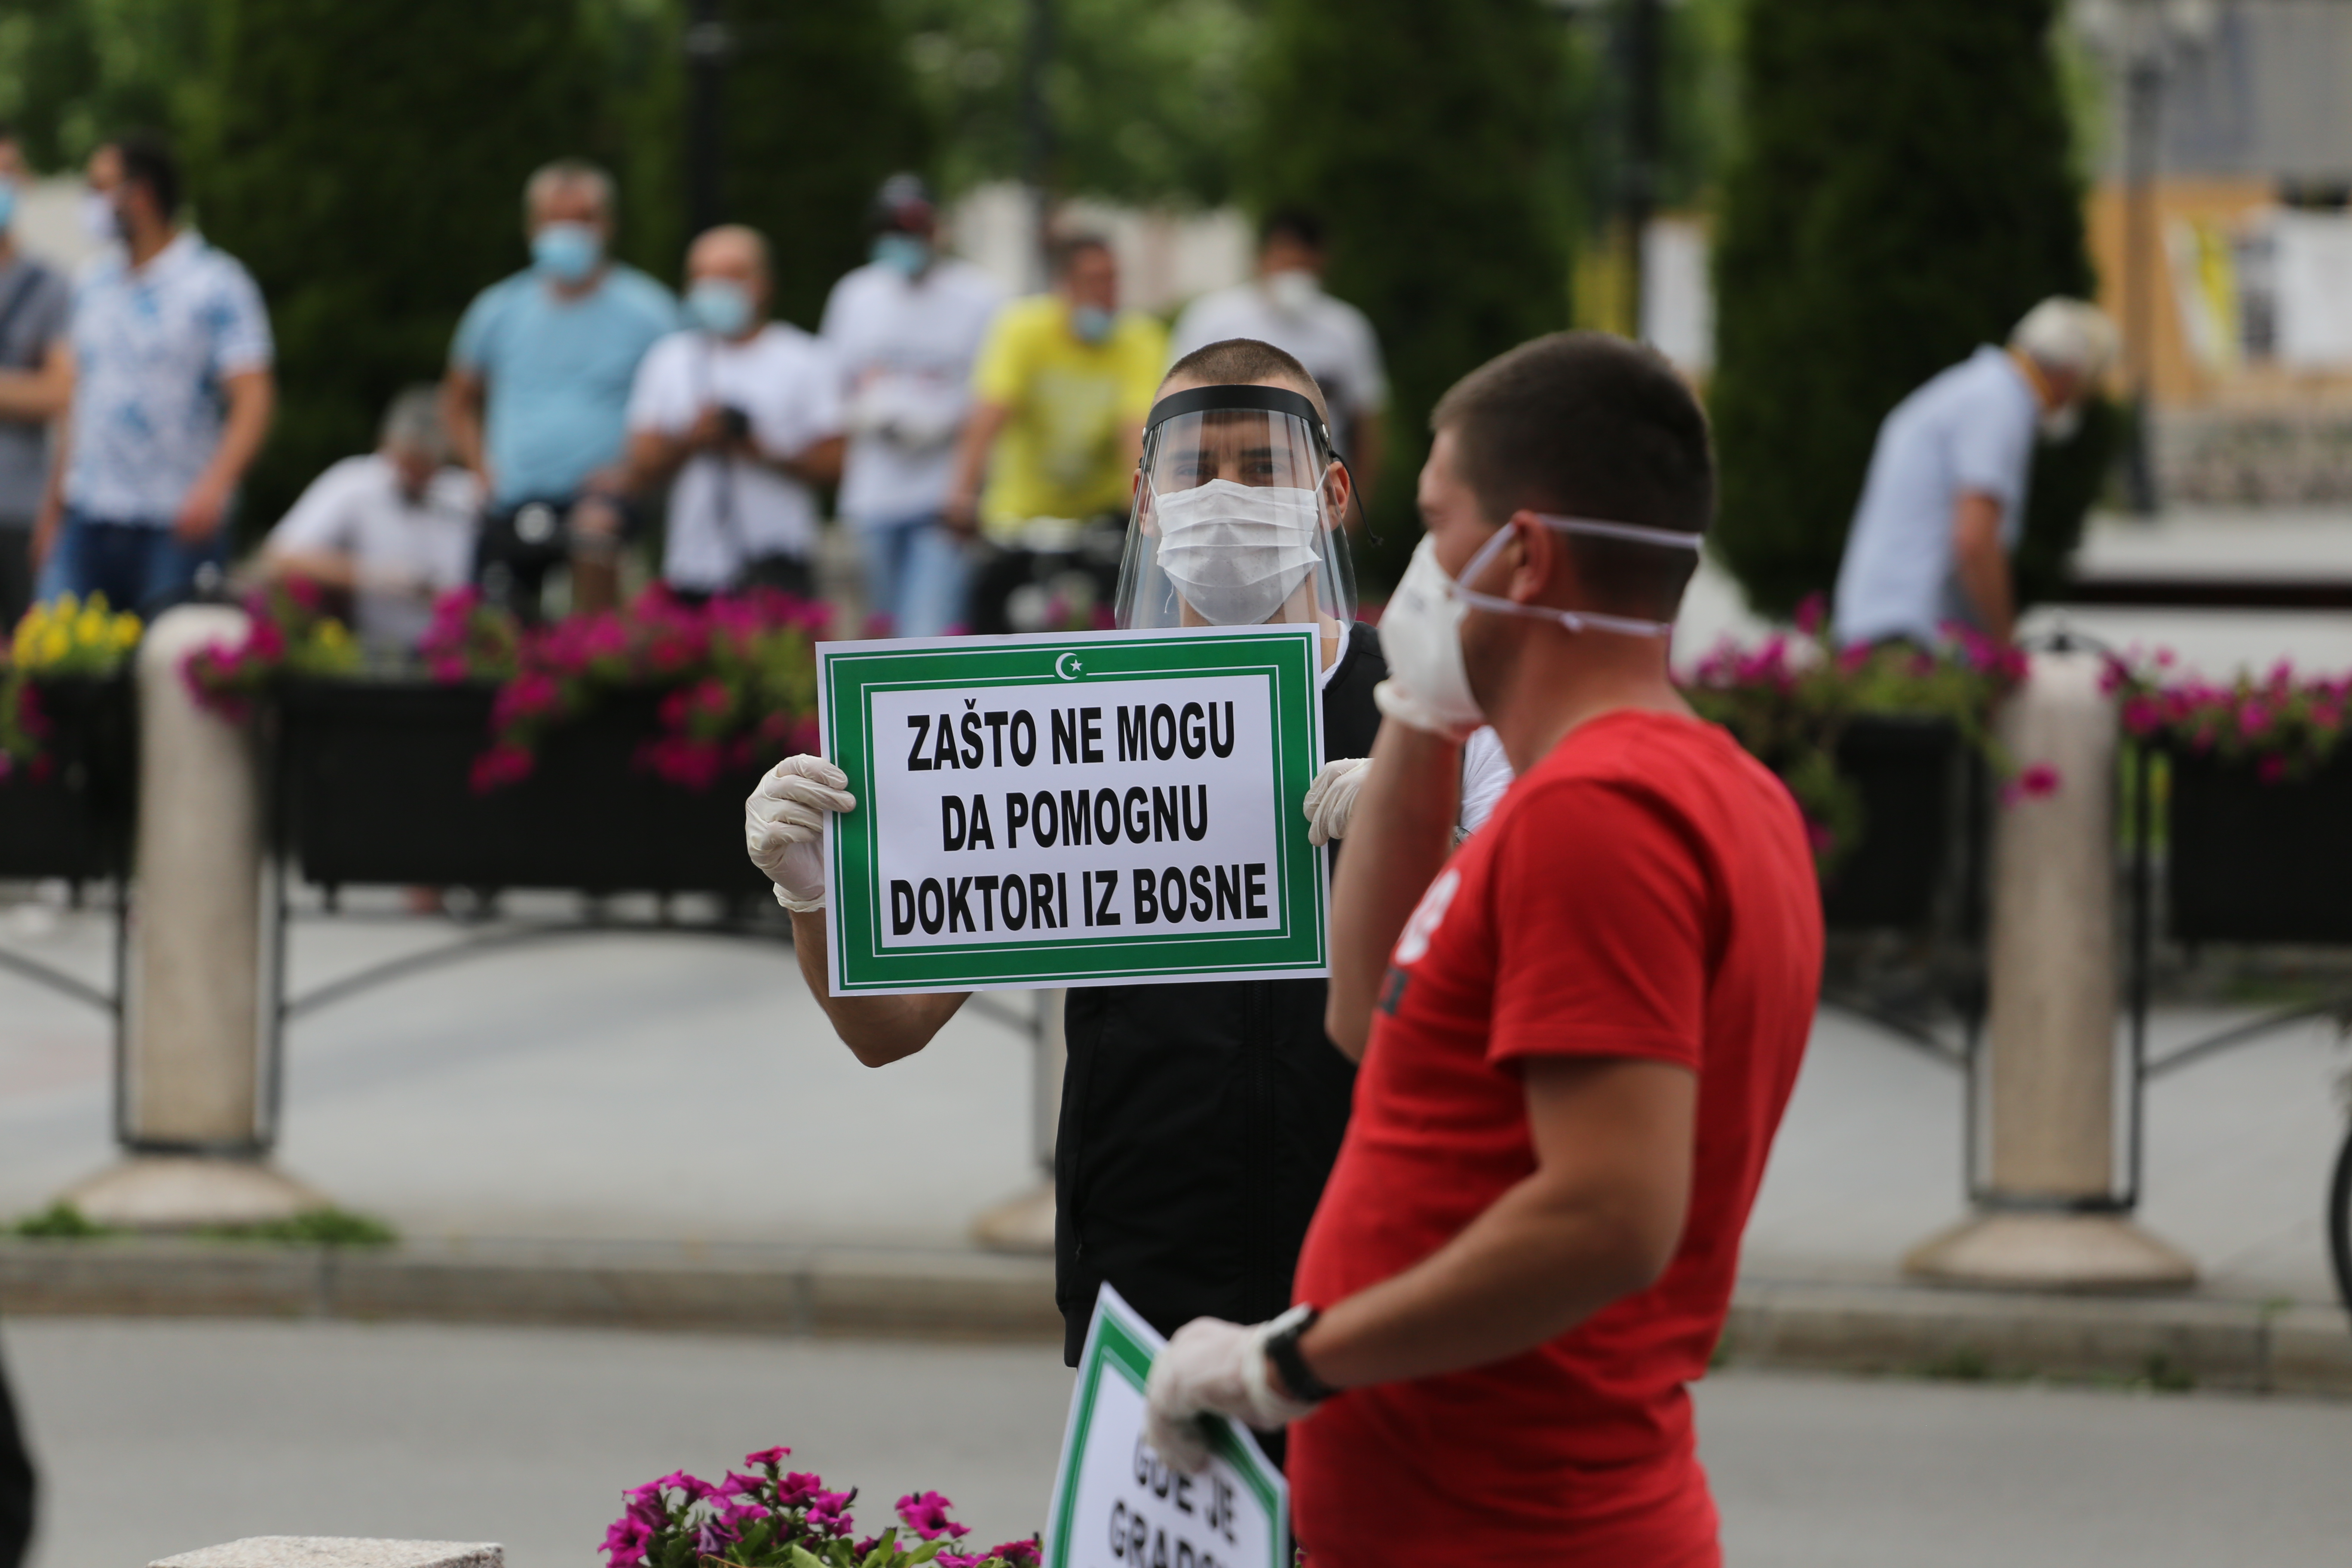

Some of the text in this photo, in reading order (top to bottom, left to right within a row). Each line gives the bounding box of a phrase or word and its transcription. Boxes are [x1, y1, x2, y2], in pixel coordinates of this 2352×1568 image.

[908, 698, 1234, 771] ZAŠTO NE MOGU
[942, 784, 1207, 851] DA POMOGNU
[890, 863, 1268, 936] DOKTORI IZ BOSNE
